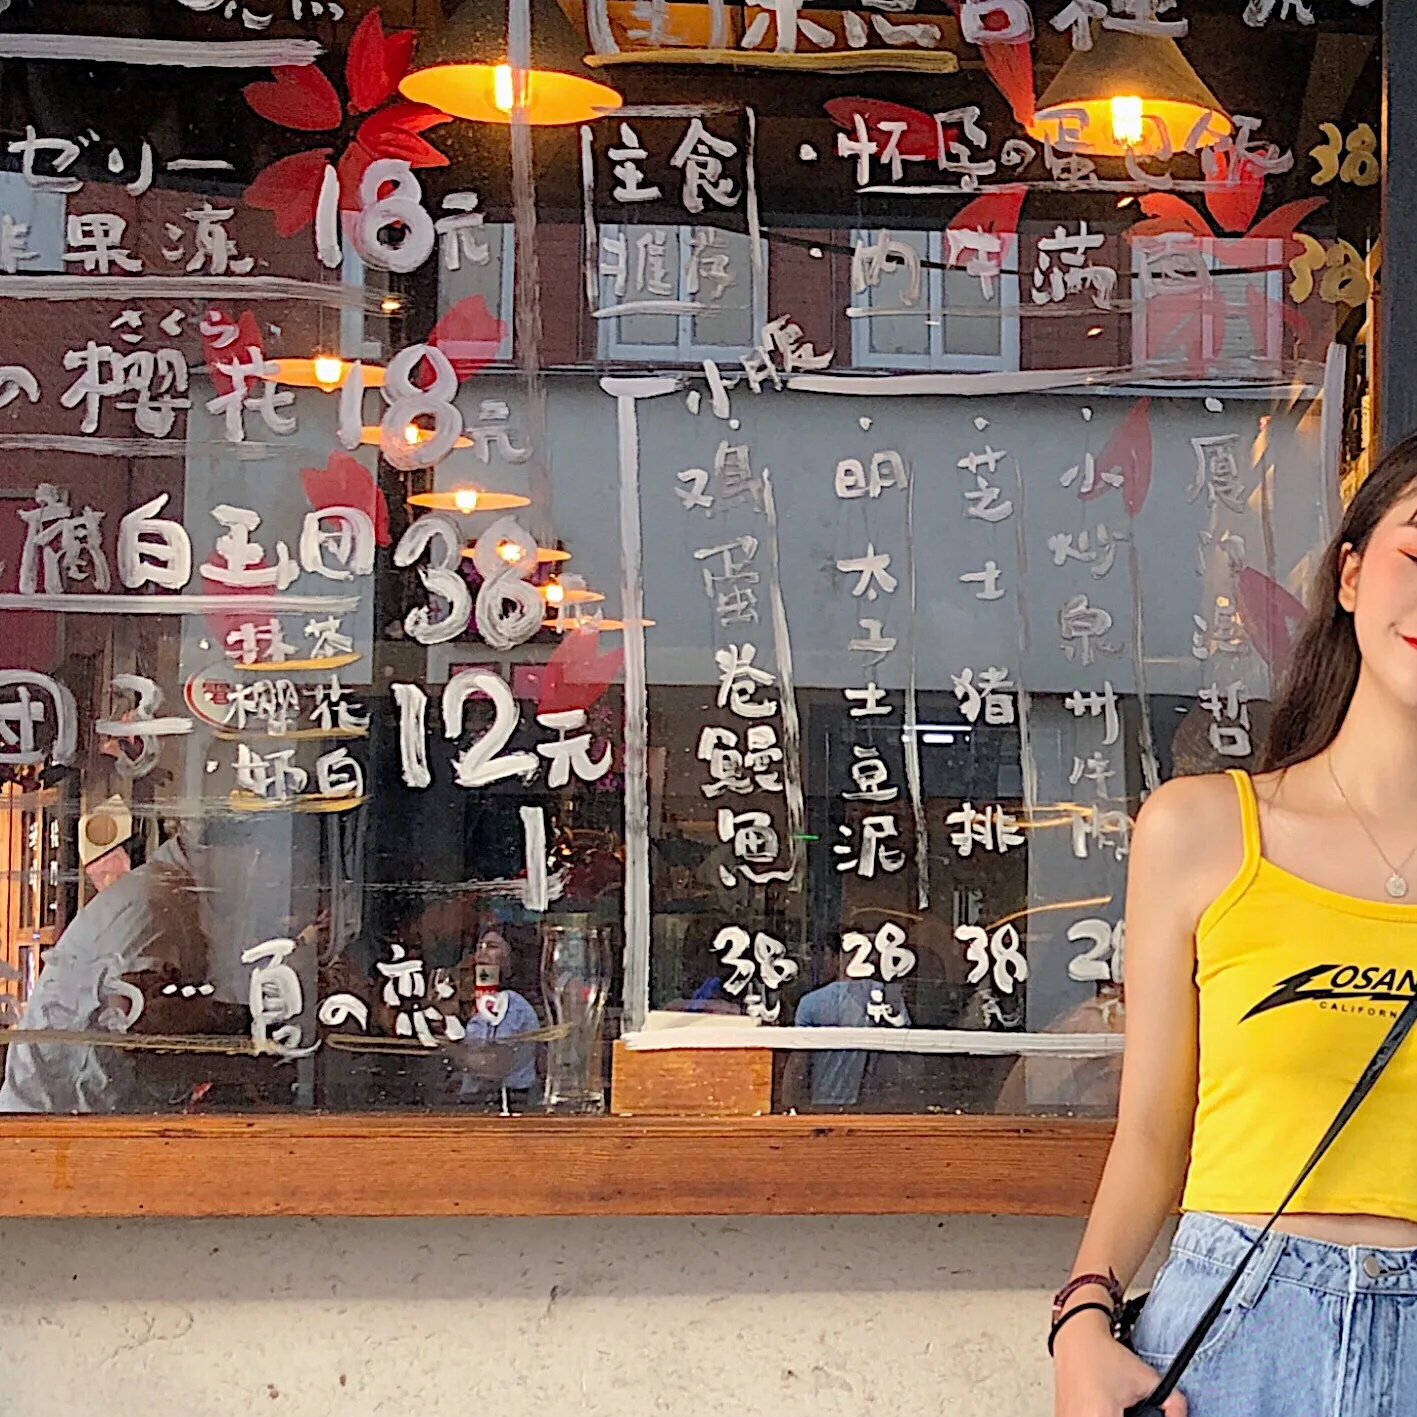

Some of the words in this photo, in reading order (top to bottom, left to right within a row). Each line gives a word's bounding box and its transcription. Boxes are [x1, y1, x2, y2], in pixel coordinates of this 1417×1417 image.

[608, 118, 741, 214] 主食
[391, 667, 611, 788] 12元
[1319, 1000, 1399, 1020] CALIFORN
